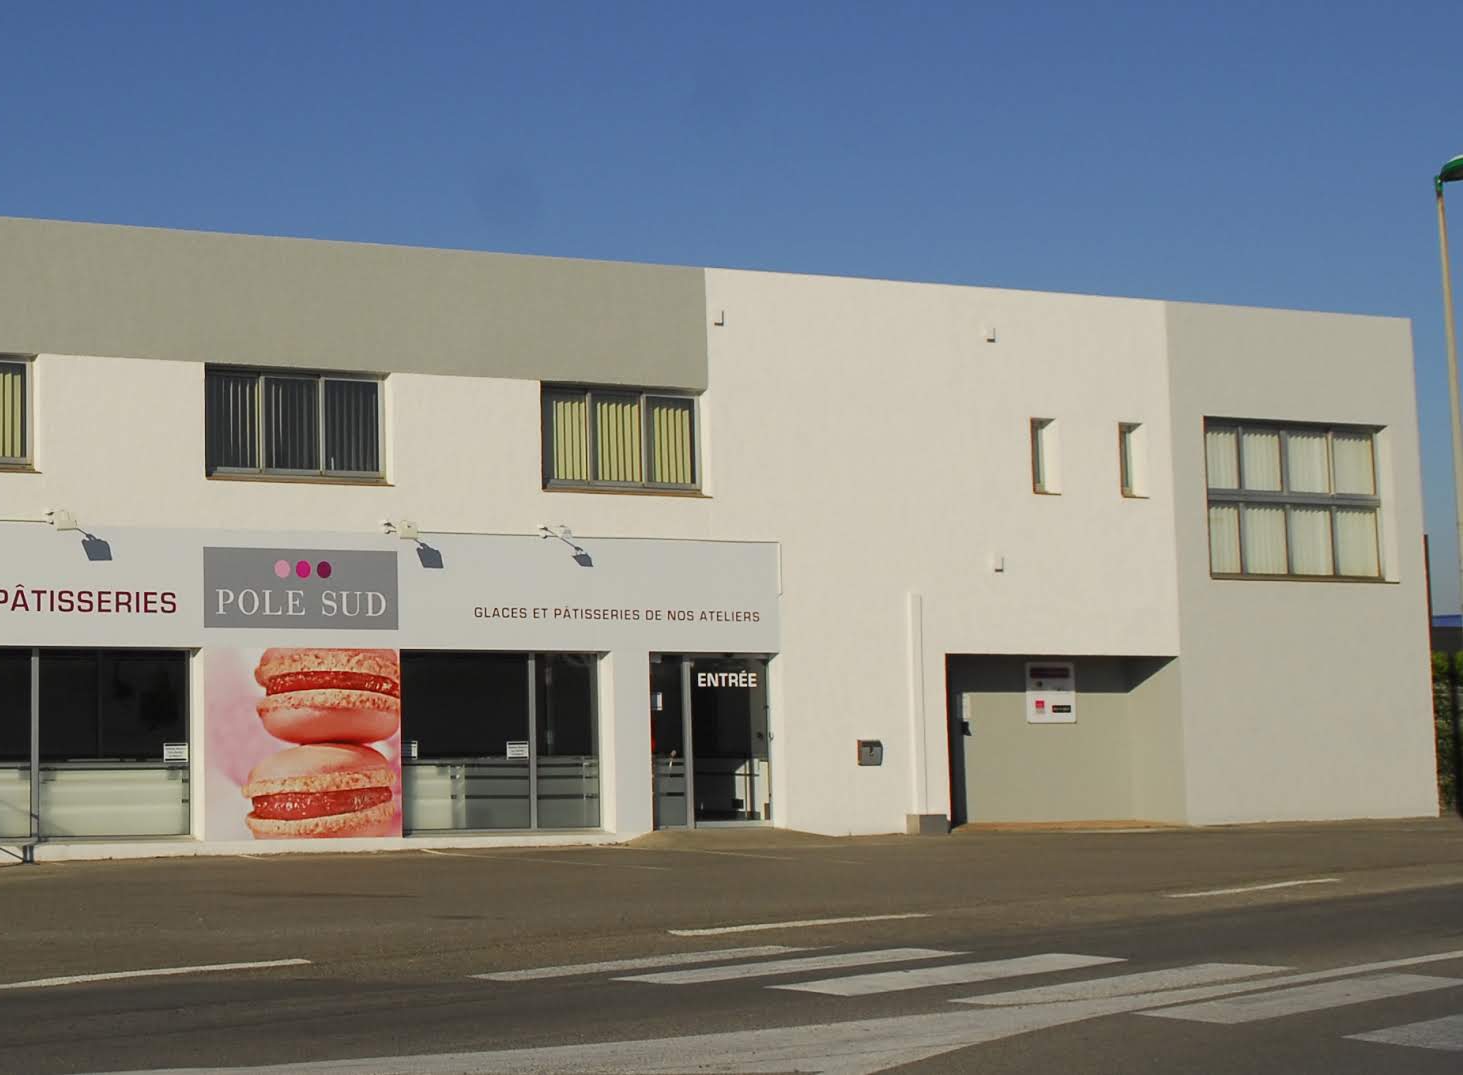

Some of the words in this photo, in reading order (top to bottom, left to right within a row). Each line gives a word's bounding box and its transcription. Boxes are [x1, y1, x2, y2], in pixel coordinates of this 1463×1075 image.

[215, 588, 306, 616] POLE
[321, 590, 387, 617] SUD
[474, 607, 527, 619] GLACES
[533, 608, 548, 619] ET
[554, 606, 640, 621] PÂTISSERIES
[646, 610, 662, 621] DE
[667, 610, 694, 622] NOS
[700, 611, 760, 622] ATELIERS
[697, 671, 757, 688] ENTRÉE
